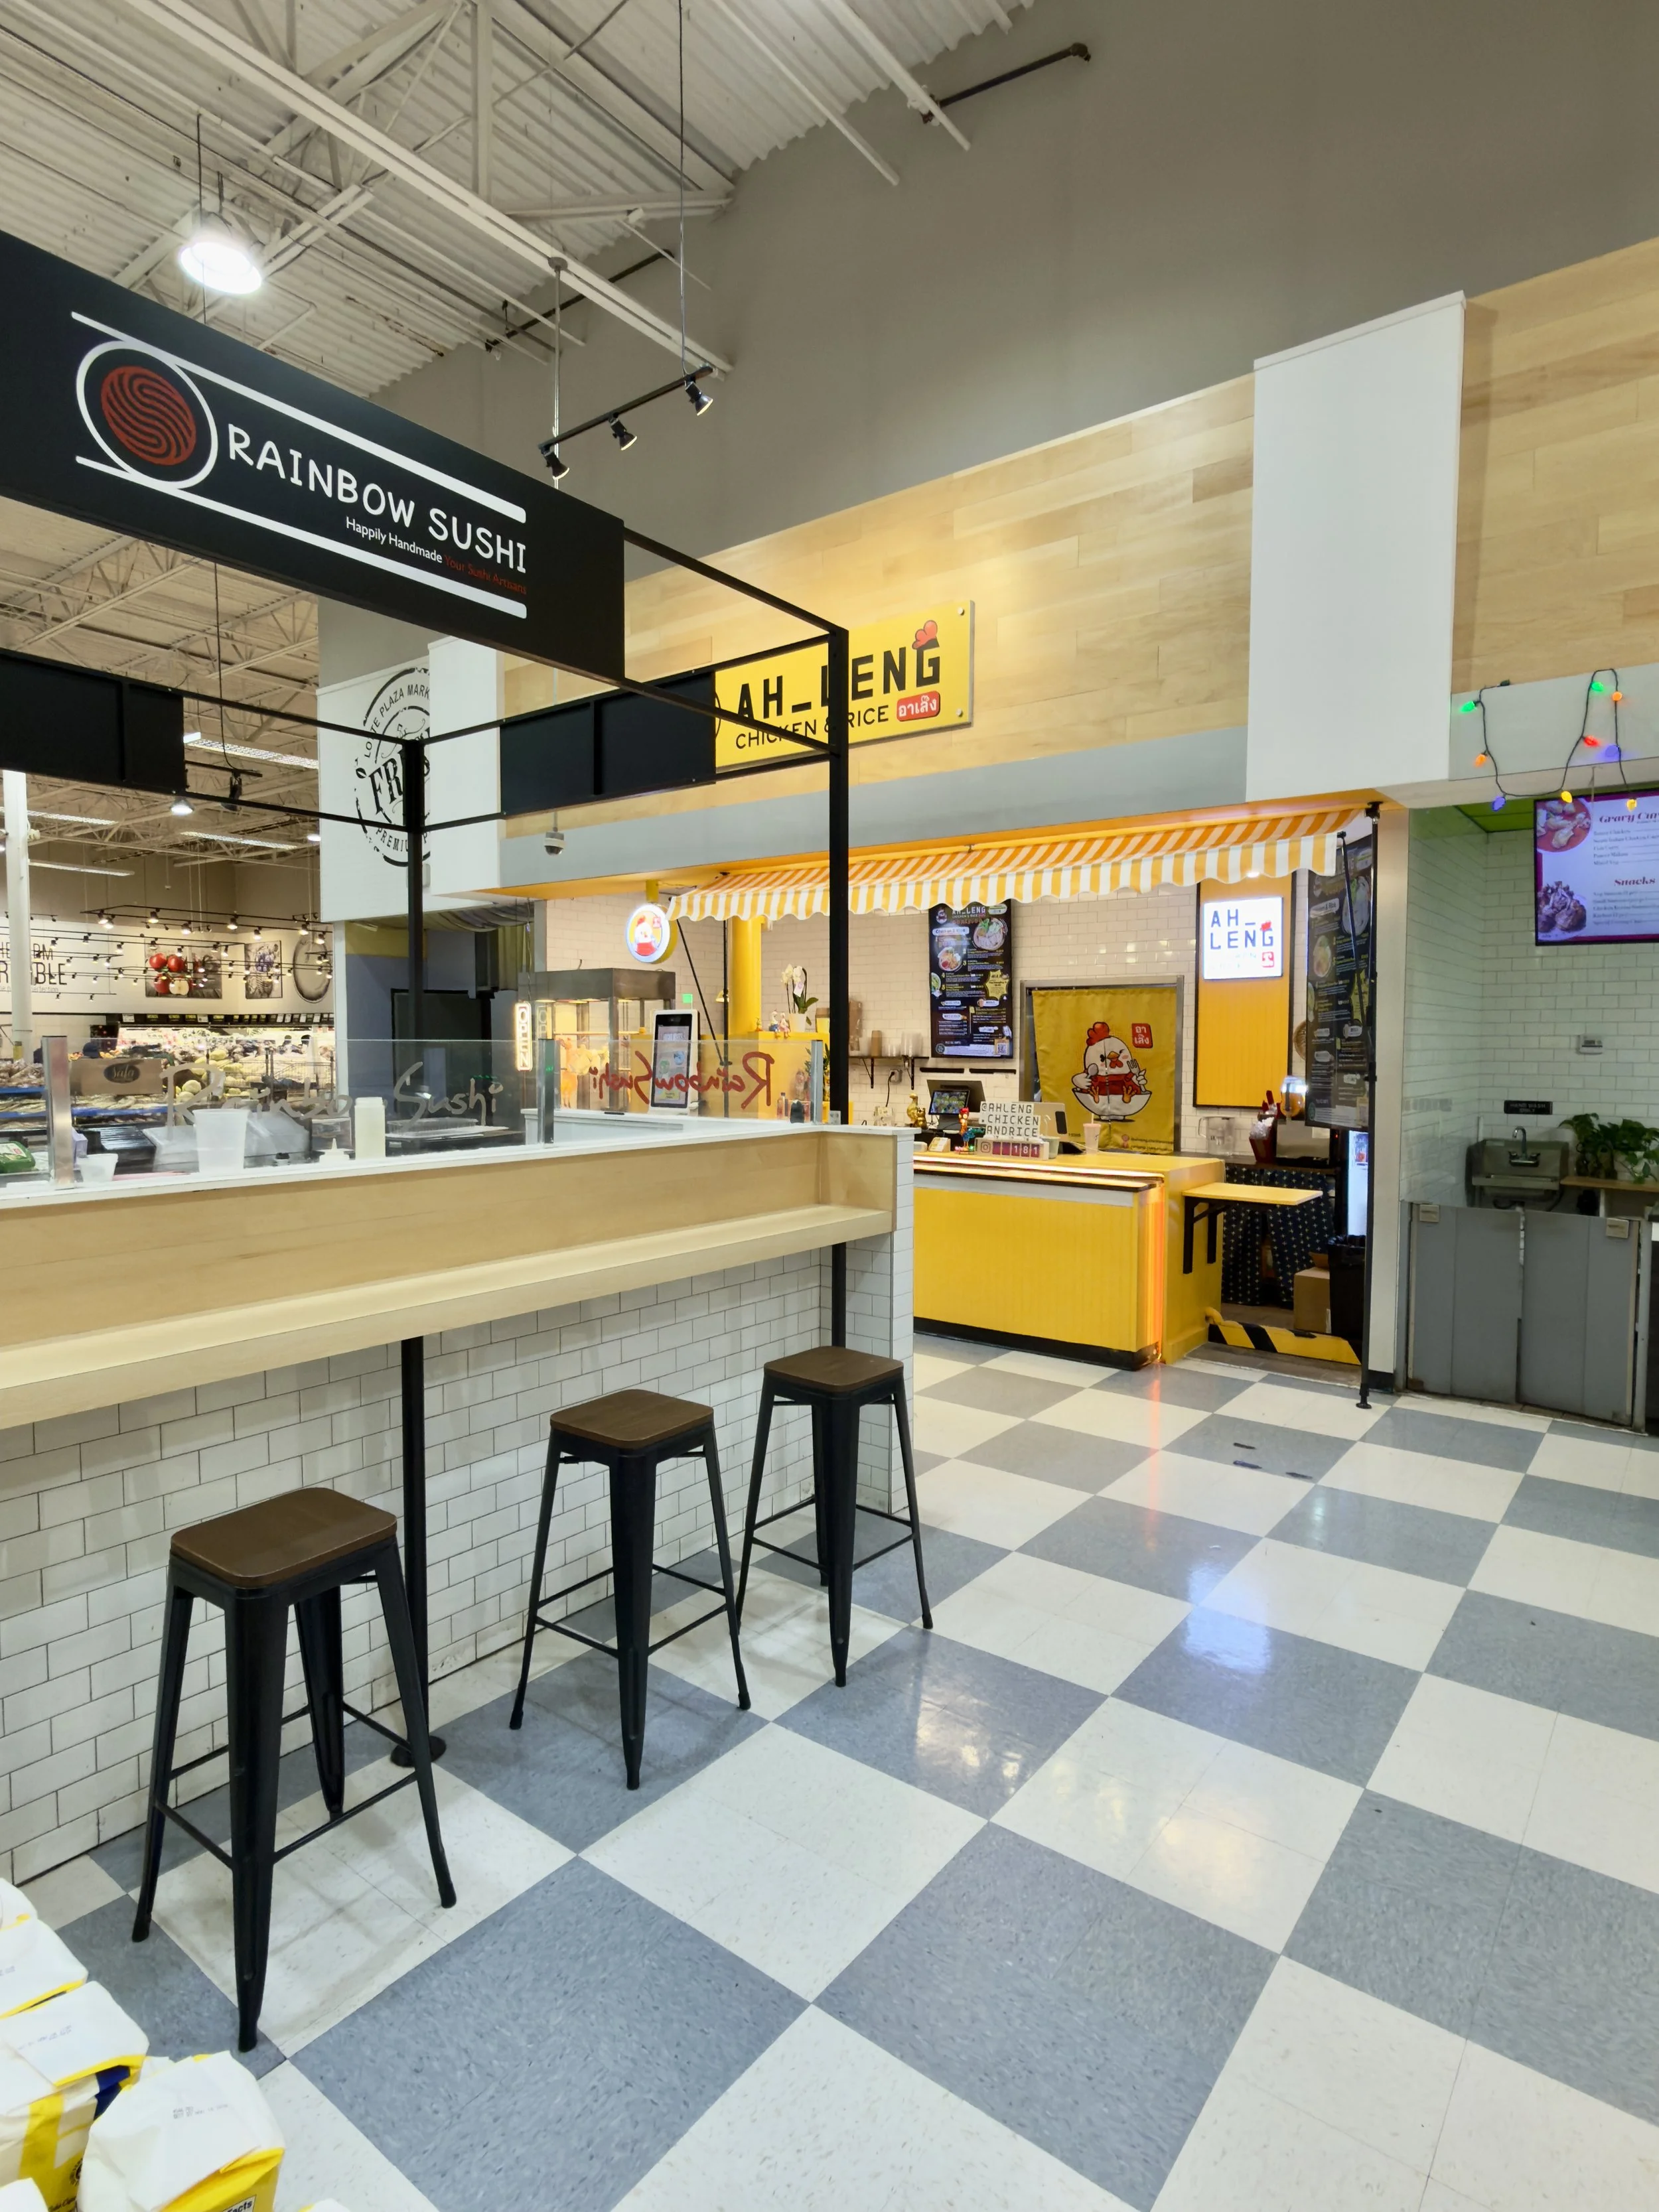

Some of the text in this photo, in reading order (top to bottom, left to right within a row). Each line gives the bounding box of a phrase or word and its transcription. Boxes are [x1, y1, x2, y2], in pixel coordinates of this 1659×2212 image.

[228, 423, 526, 573] RAINBOW SUSHI
[346, 516, 527, 595] Happily Handmade Your Sushi Artisans
[364, 717, 380, 758] LOTE
[380, 688, 404, 717] PLAZA
[848, 705, 889, 728] RICE
[376, 827, 409, 852] PREMIU
[1615, 876, 1656, 886] Snacks
[1210, 929, 1273, 949] LENG
[519, 1008, 529, 1068] OPEN
[394, 1062, 504, 1131] Sushi
[981, 1103, 1032, 1113] @AHLENG
[987, 1126, 1038, 1137] ANDRICE
